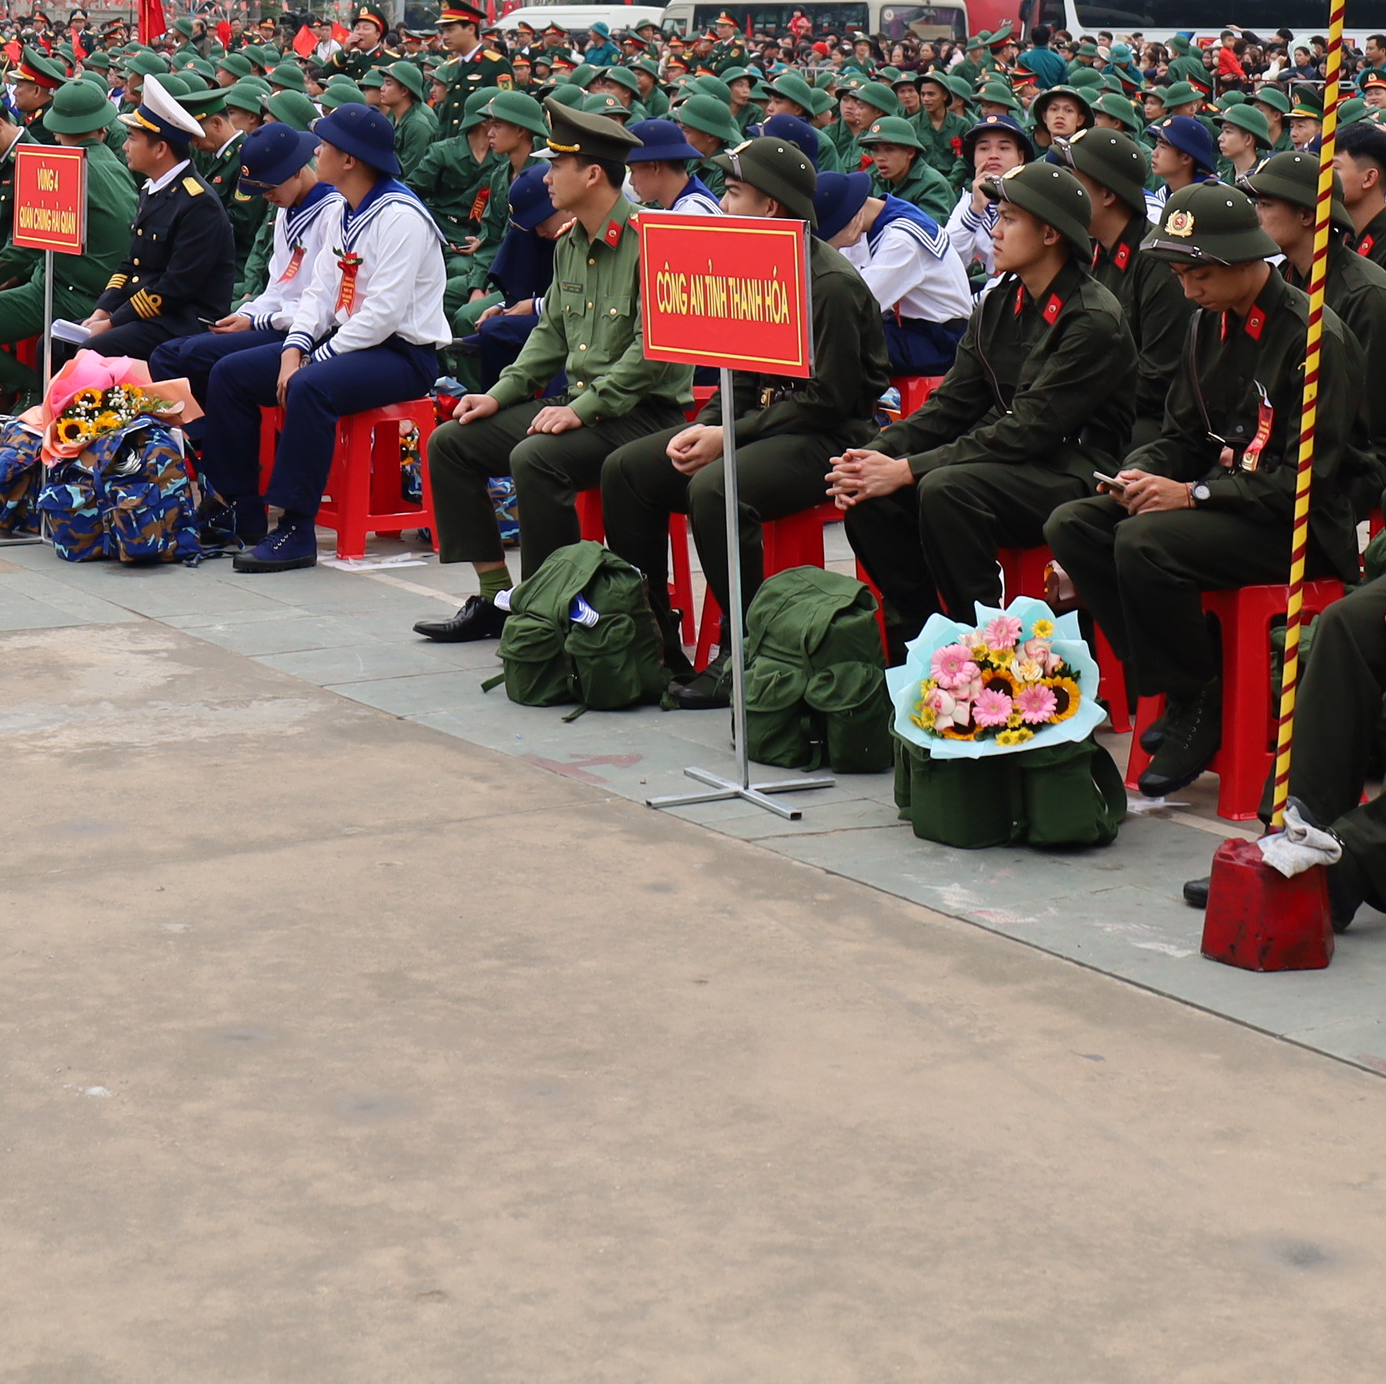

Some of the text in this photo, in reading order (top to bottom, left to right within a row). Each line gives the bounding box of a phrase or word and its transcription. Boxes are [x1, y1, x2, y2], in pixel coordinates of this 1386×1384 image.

[37, 161, 59, 192] VÙNG 4
[19, 200, 76, 234] QUÂN CHỦNG HẢI QUÂN
[656, 259, 791, 324] CÔNG AN TỈNH THANH HÓA
